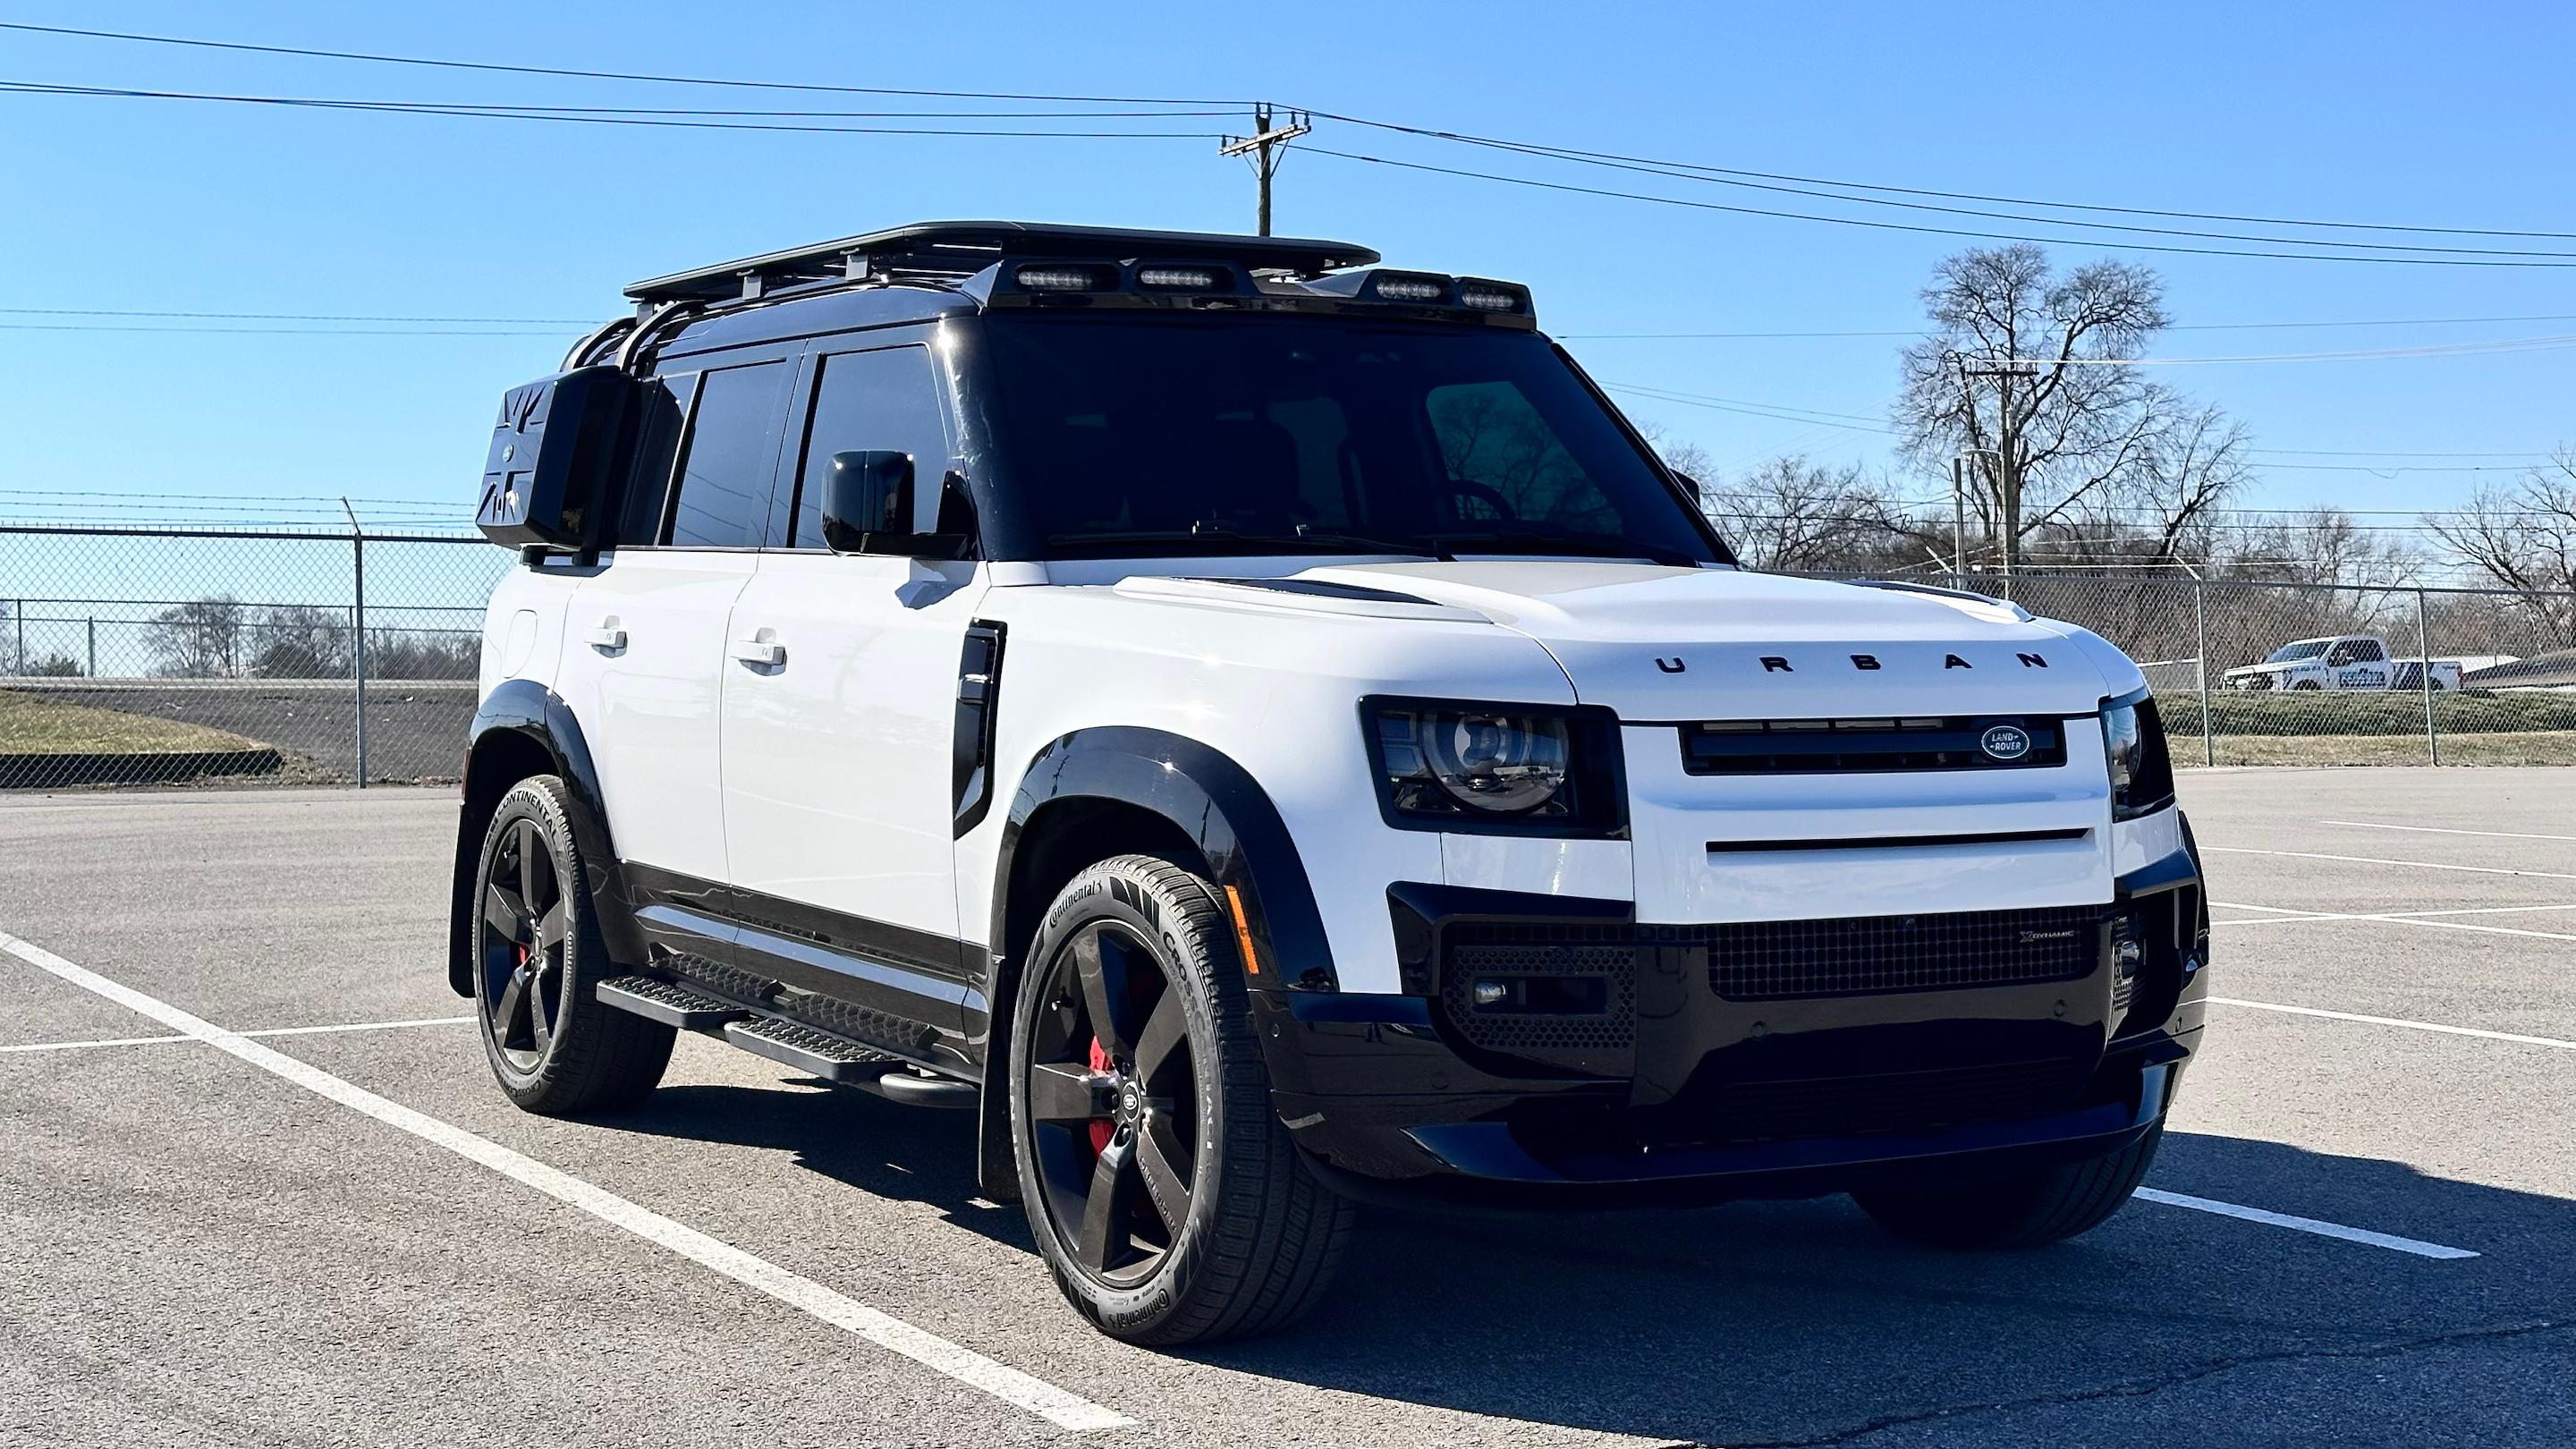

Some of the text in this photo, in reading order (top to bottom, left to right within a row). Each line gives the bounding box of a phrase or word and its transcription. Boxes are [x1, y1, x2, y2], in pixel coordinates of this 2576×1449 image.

[1655, 653, 2049, 674] URBAN
[497, 791, 556, 844] CONTINENTAL
[1049, 880, 1096, 928] Continental
[1115, 1288, 1171, 1329] Continental
